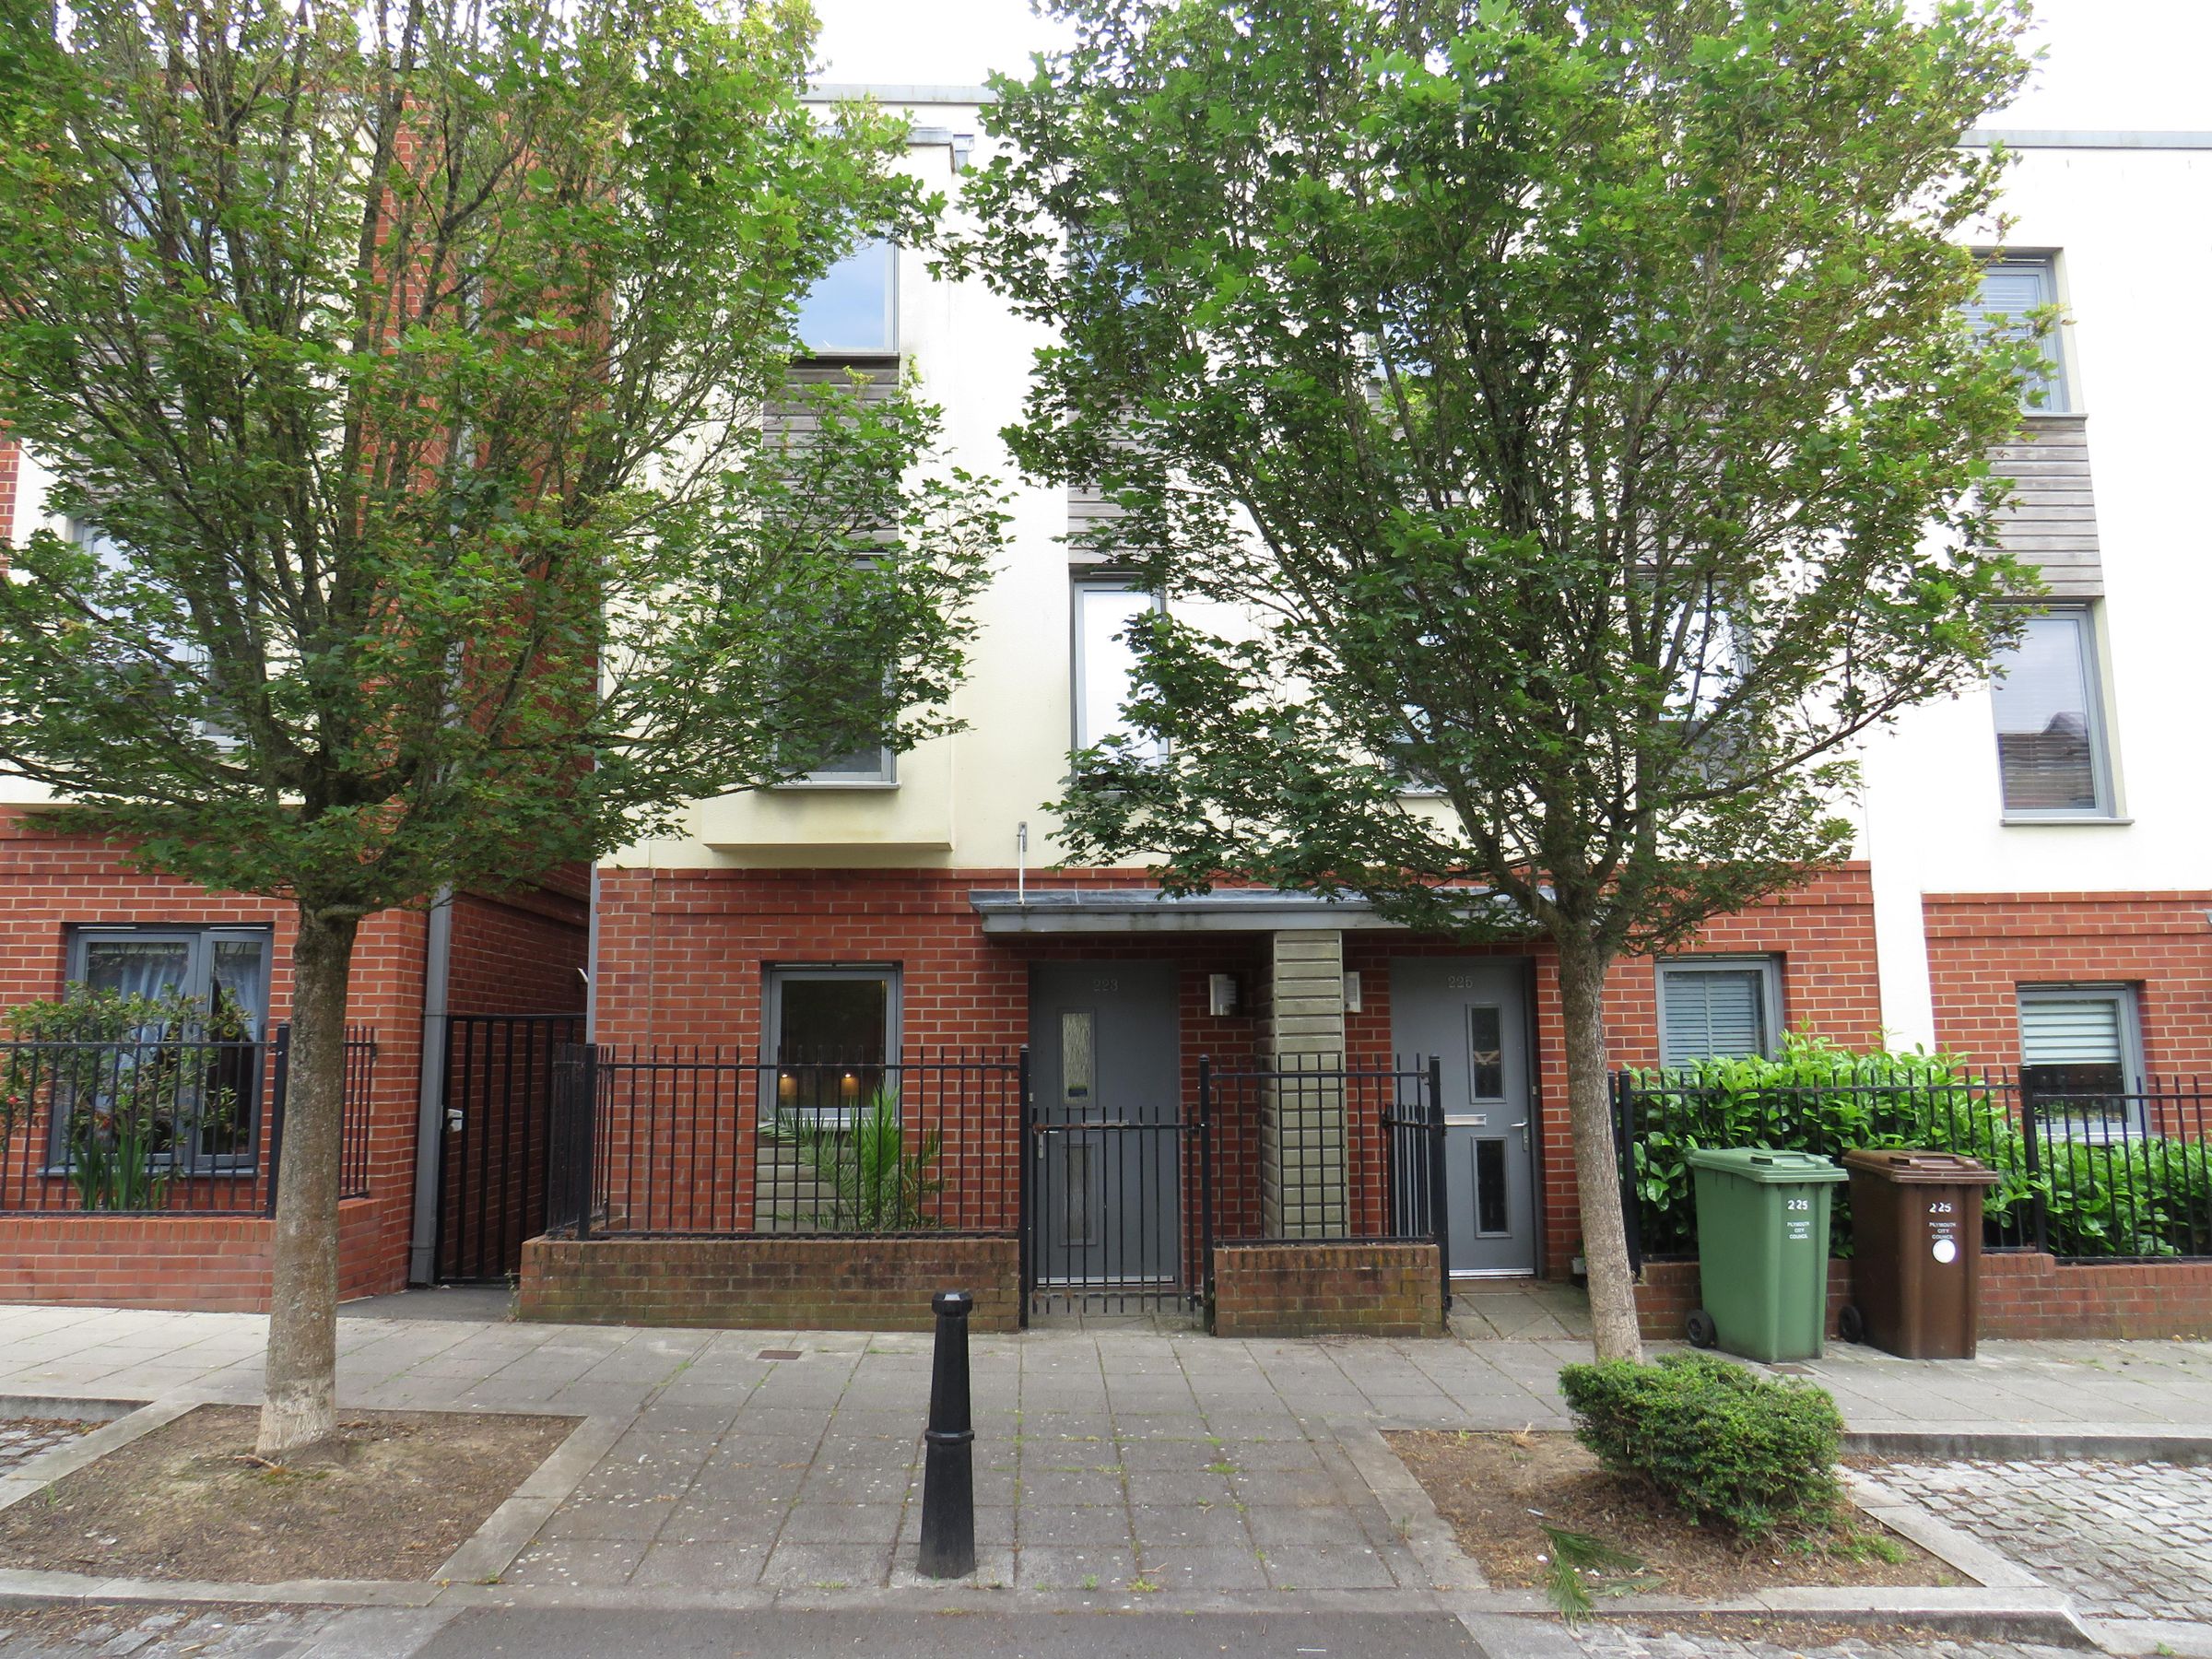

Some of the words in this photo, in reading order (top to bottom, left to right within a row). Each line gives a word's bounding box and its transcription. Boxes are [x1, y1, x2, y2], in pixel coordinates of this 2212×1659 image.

[1448, 975, 1473, 988] 225
[1787, 1199, 1808, 1210] 225
[1929, 1202, 1951, 1213] 225
